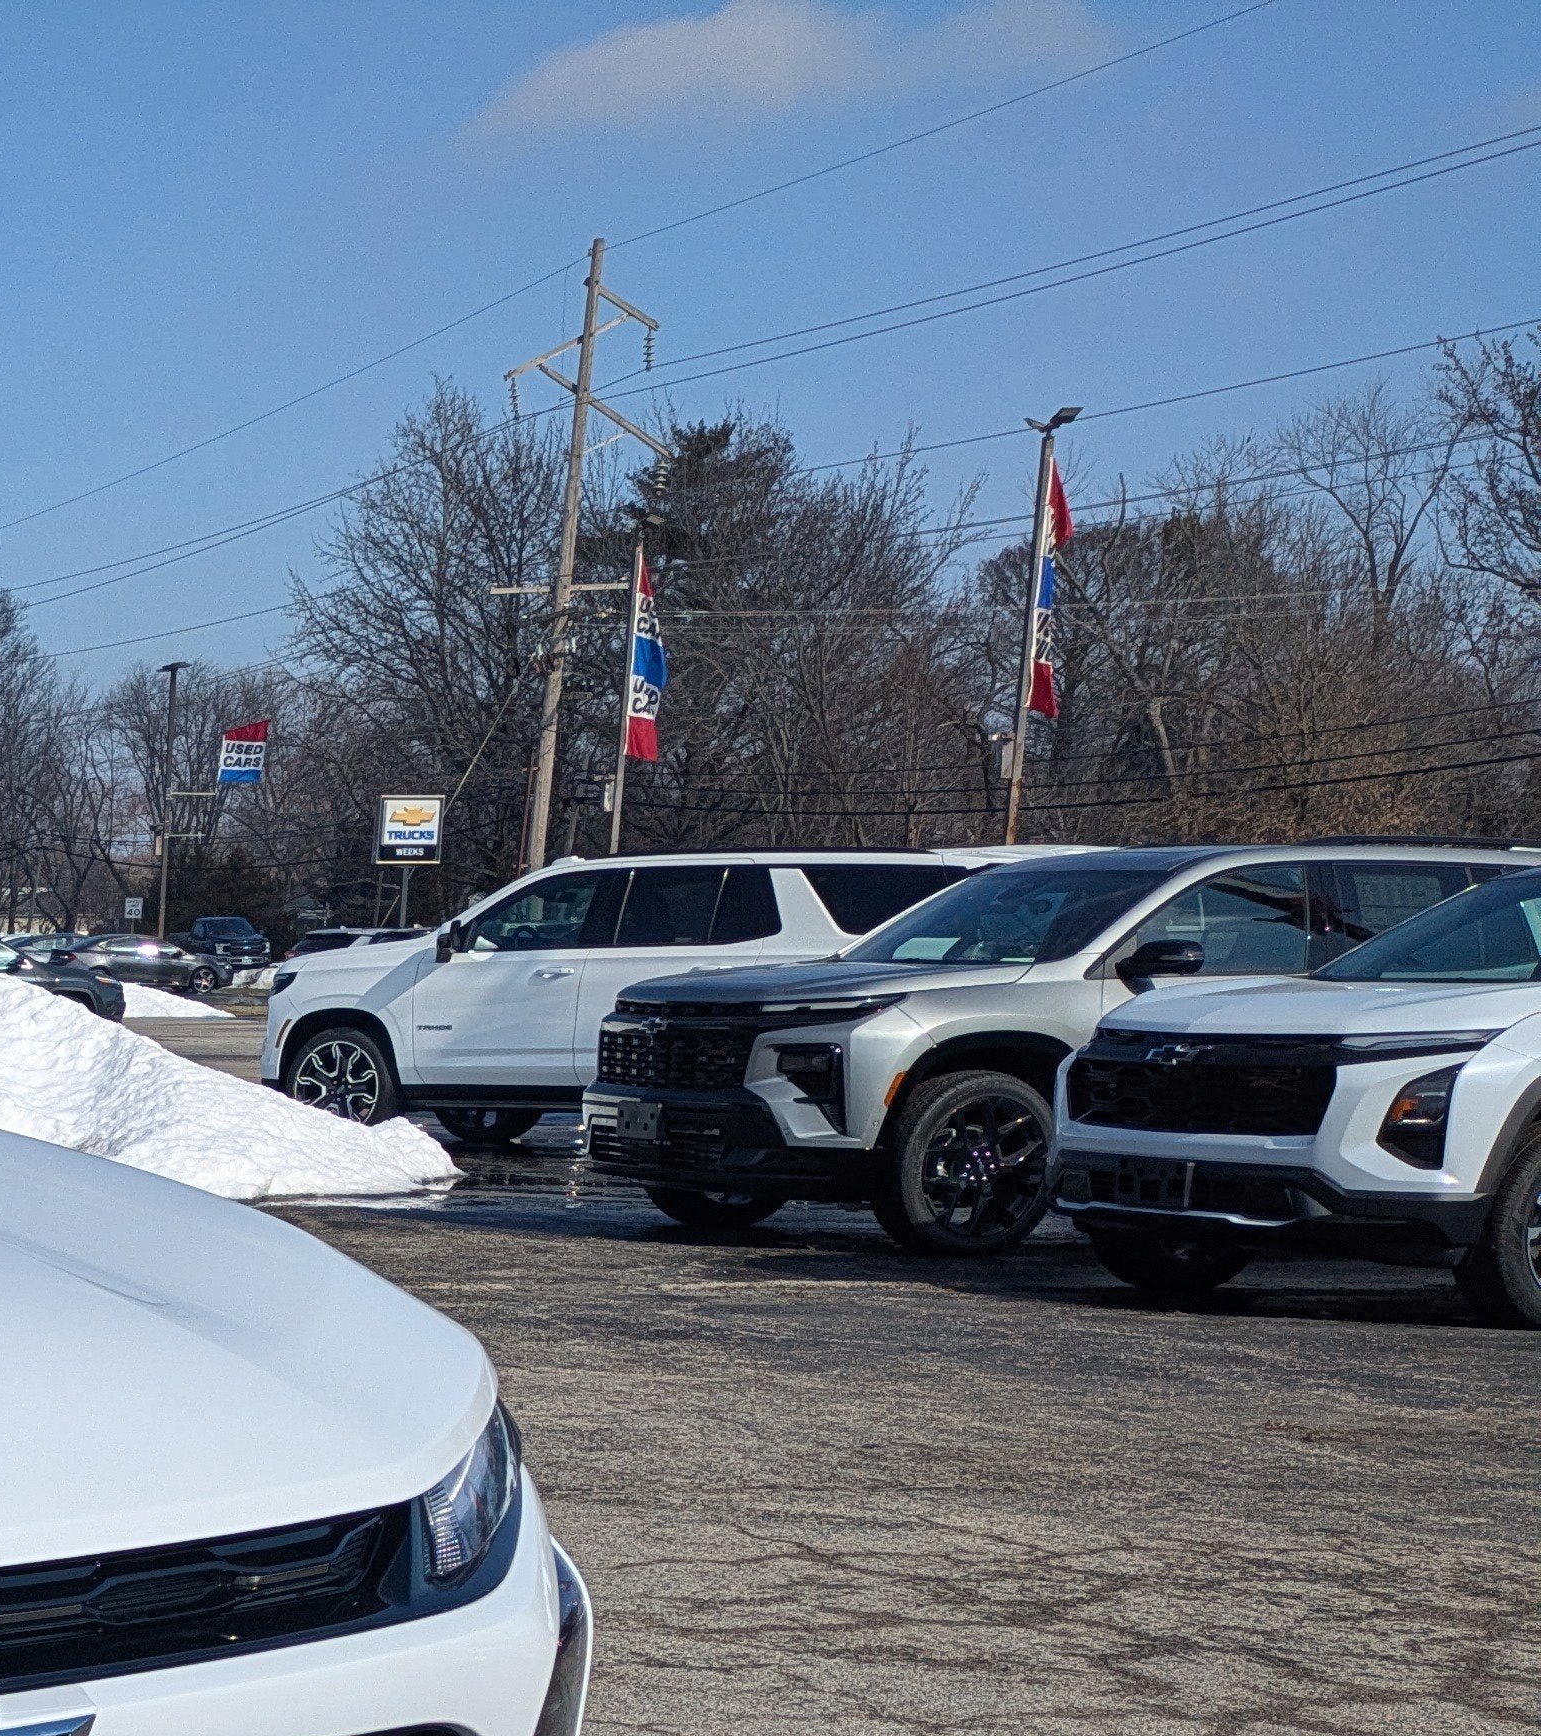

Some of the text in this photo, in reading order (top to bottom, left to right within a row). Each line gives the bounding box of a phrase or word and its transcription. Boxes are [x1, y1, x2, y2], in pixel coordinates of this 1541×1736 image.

[226, 743, 263, 755] USED
[223, 755, 261, 768] CARS
[386, 829, 435, 841] TRUCKS
[395, 847, 425, 857] WEEKS
[127, 908, 141, 917] 40
